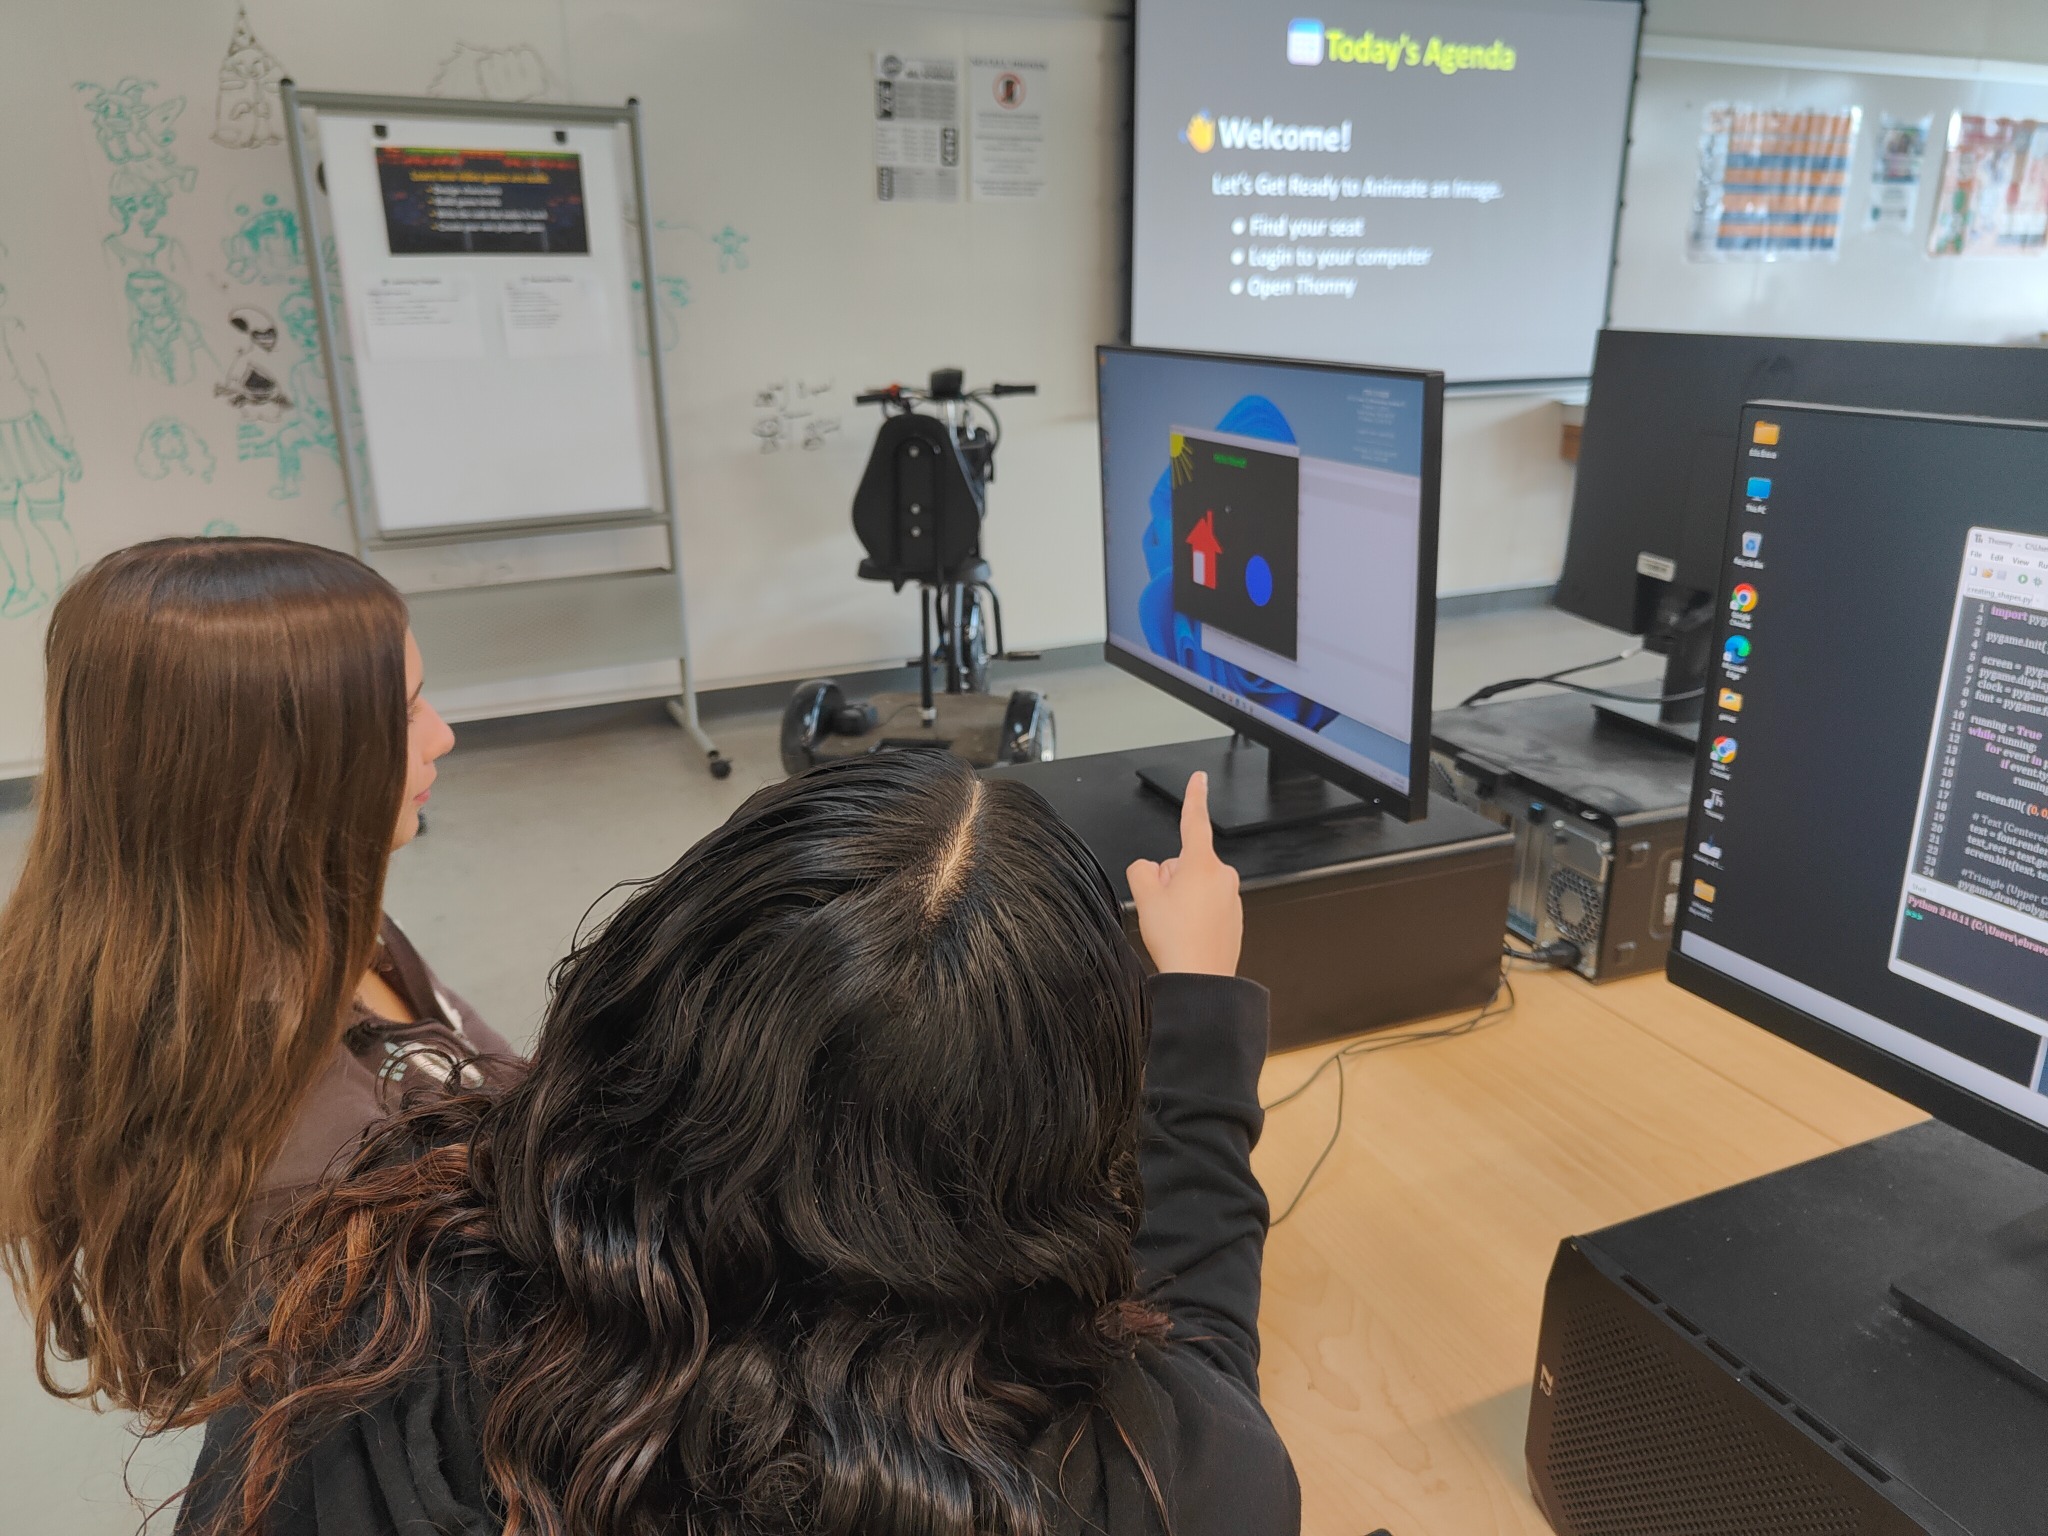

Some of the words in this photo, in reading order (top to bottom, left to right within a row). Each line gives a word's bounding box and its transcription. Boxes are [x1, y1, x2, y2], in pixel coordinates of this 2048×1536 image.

[1325, 28, 1420, 71] Today's
[1423, 37, 1516, 74] Agenda
[1218, 116, 1352, 153] Welcome!
[1212, 172, 1253, 196] Let's
[1254, 172, 1287, 196] Get
[1288, 172, 1341, 201] Ready
[1341, 176, 1361, 198] to
[1361, 175, 1429, 199] Animate
[1430, 179, 1450, 199] an
[1249, 213, 1289, 237] Find
[1289, 218, 1328, 241] your
[1328, 216, 1366, 237] seat
[1249, 245, 1295, 271] Login
[1296, 246, 1315, 266] to
[1316, 248, 1355, 271] your
[1355, 246, 1433, 270] computer
[1247, 274, 1295, 301] Open
[1970, 550, 1982, 558] File
[1990, 553, 2004, 562] Edit
[2012, 557, 2029, 566] View
[1991, 606, 2028, 621] import
[2028, 614, 2048, 628] pyg
[1981, 655, 2013, 670] screen
[1975, 690, 1995, 704] font
[1977, 679, 2003, 694] clock
[1968, 727, 1997, 741] while
[1970, 715, 2007, 734] running
[2016, 725, 2043, 741] True
[1985, 742, 2002, 755] for
[2002, 750, 2031, 763] event
[2031, 755, 2043, 767] in
[1969, 823, 1989, 837] text
[1981, 814, 2003, 828] Text
[2006, 883, 2040, 903] (Upper
[1907, 895, 1939, 915] Python
